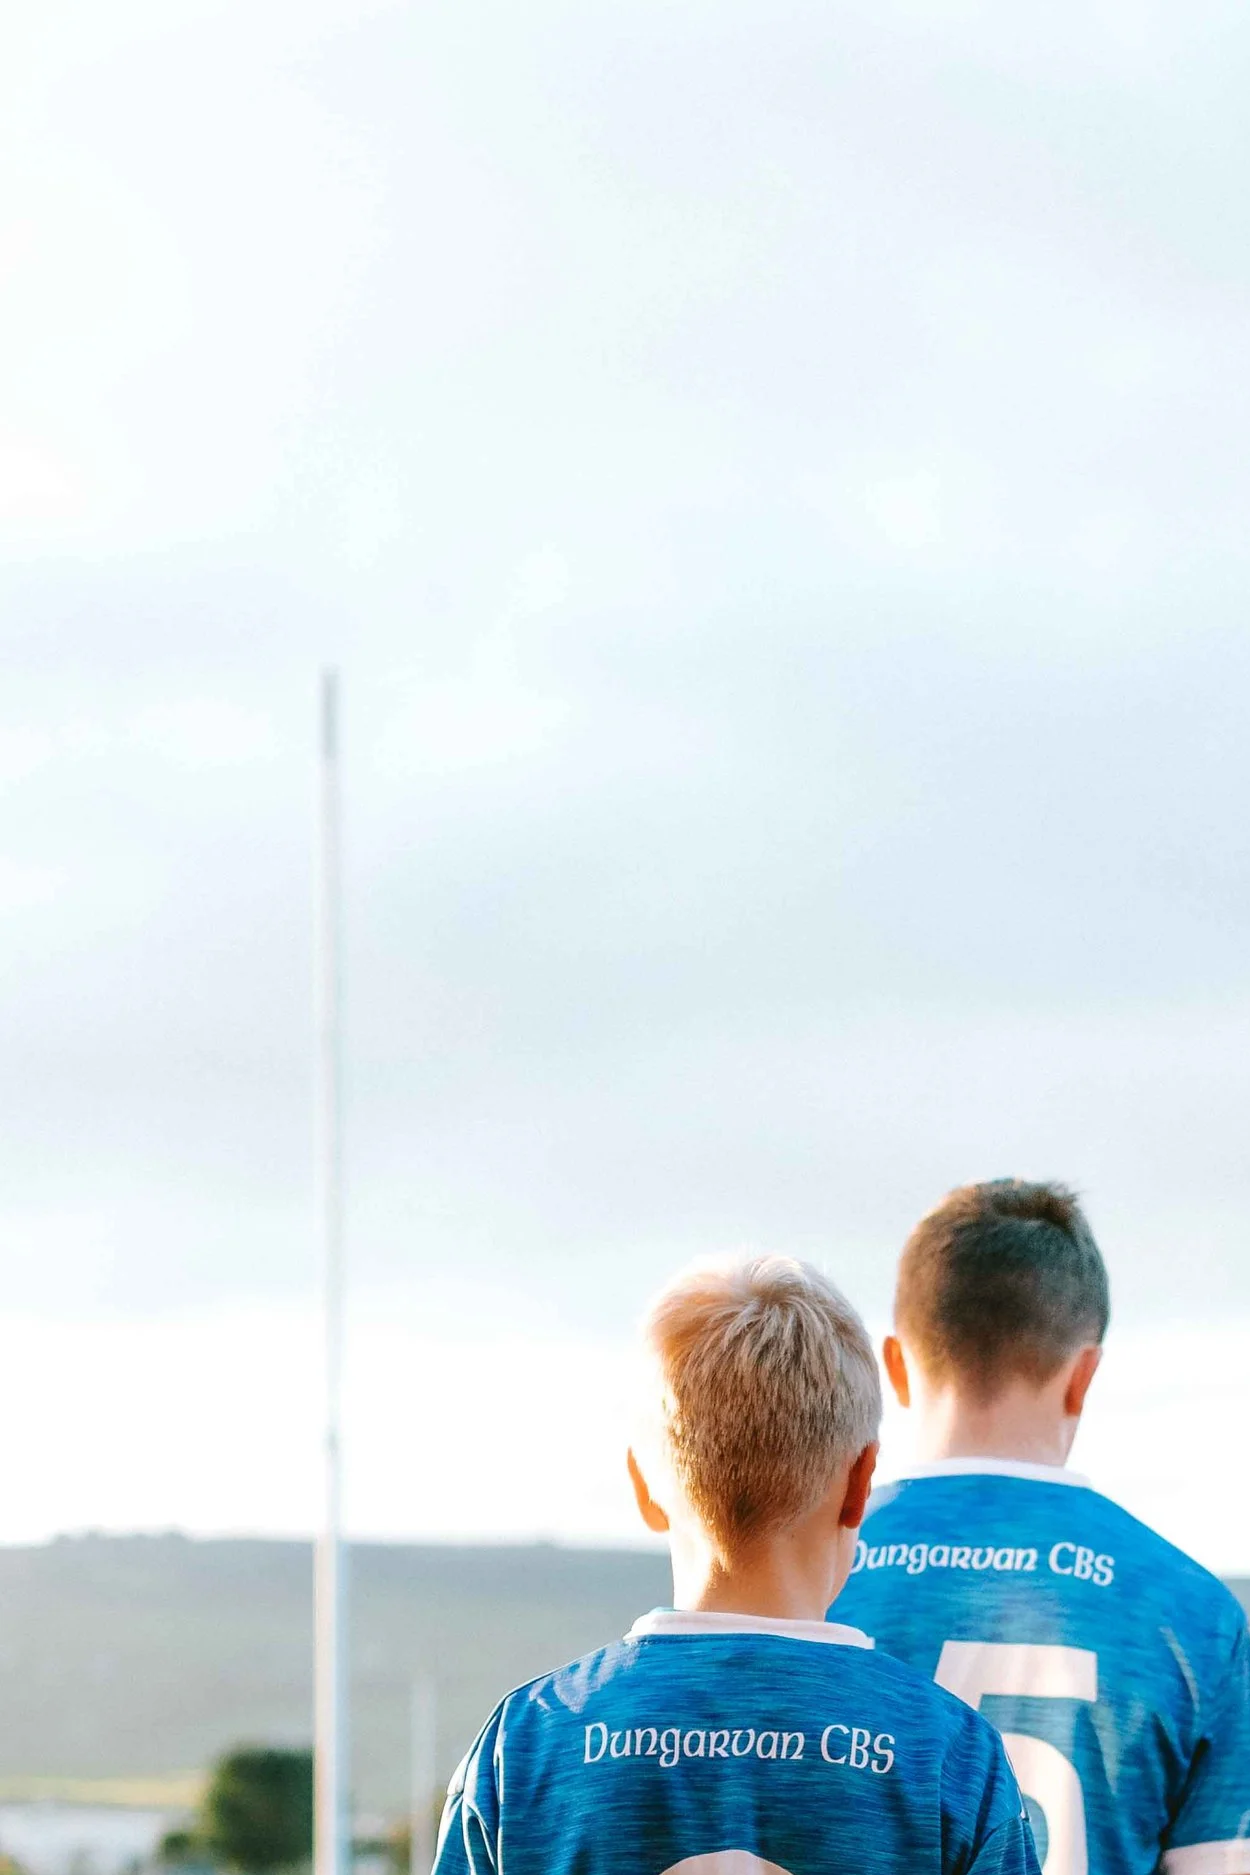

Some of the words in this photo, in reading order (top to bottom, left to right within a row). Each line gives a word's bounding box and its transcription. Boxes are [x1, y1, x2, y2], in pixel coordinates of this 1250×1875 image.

[1049, 1541, 1116, 1586] CBS
[584, 1722, 805, 1767] Dungarvan
[820, 1724, 896, 1774] CBS
